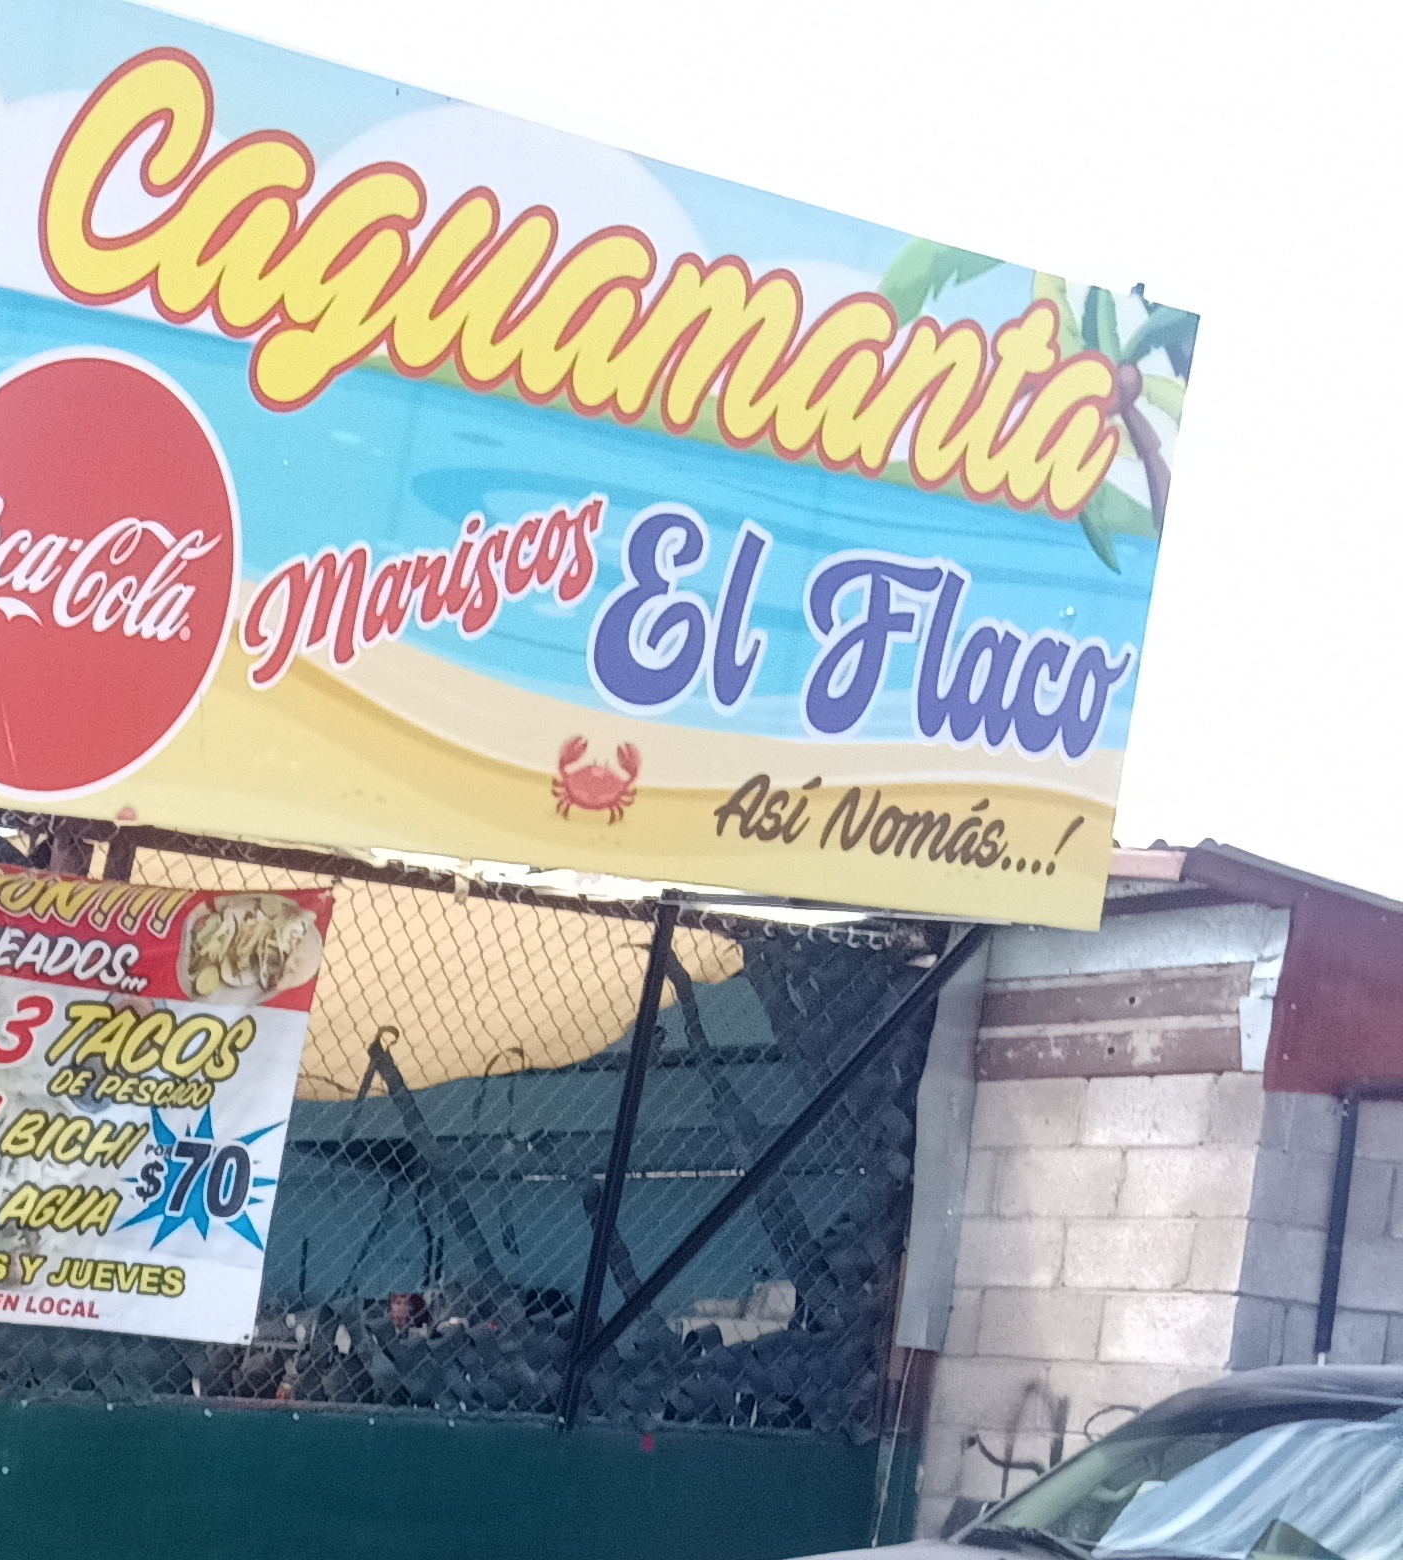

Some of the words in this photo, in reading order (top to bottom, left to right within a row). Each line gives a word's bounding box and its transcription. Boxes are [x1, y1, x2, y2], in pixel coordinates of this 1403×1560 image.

[39, 46, 1124, 520] Caguamanta
[244, 500, 604, 685] Mariscos
[591, 512, 768, 708] El
[805, 553, 1132, 760] Flaco
[713, 773, 823, 844] Así
[43, 1000, 258, 1084] TACOS
[46, 1066, 93, 1099] DE
[134, 1139, 254, 1222] $70
[17, 1254, 50, 1287] Y
[46, 1257, 187, 1300] JUEVES
[24, 1298, 102, 1321] LOCAL
